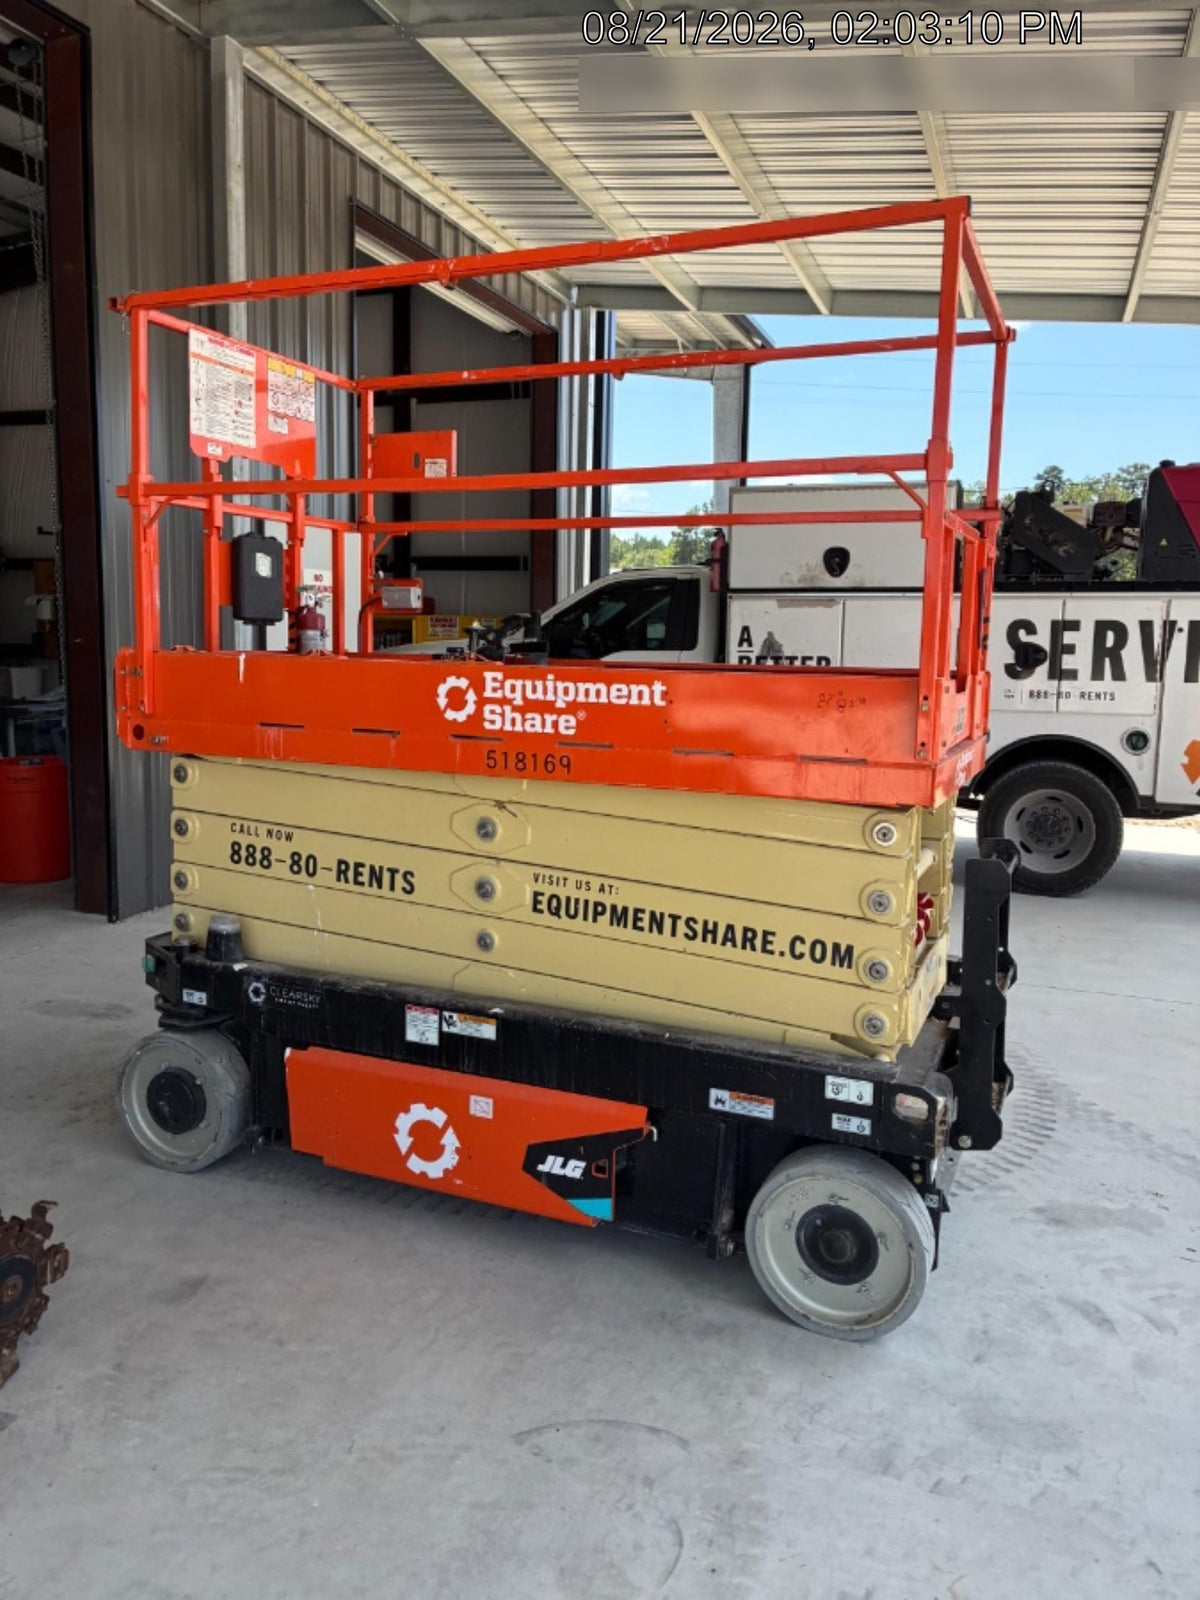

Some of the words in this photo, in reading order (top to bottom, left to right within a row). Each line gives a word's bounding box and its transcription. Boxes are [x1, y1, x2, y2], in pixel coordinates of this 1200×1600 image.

[737, 625, 753, 648] A
[482, 670, 668, 708] Equipment
[486, 749, 572, 775] 518169
[230, 822, 260, 838] CALL
[266, 828, 294, 843] NOW
[229, 840, 416, 895] 888-80-RENTS
[532, 871, 569, 888] VISIT
[575, 879, 592, 892] US
[598, 882, 620, 896] AT:
[531, 890, 855, 970] EQUIPMENTSHARE.COM
[536, 1154, 588, 1180] JLG
